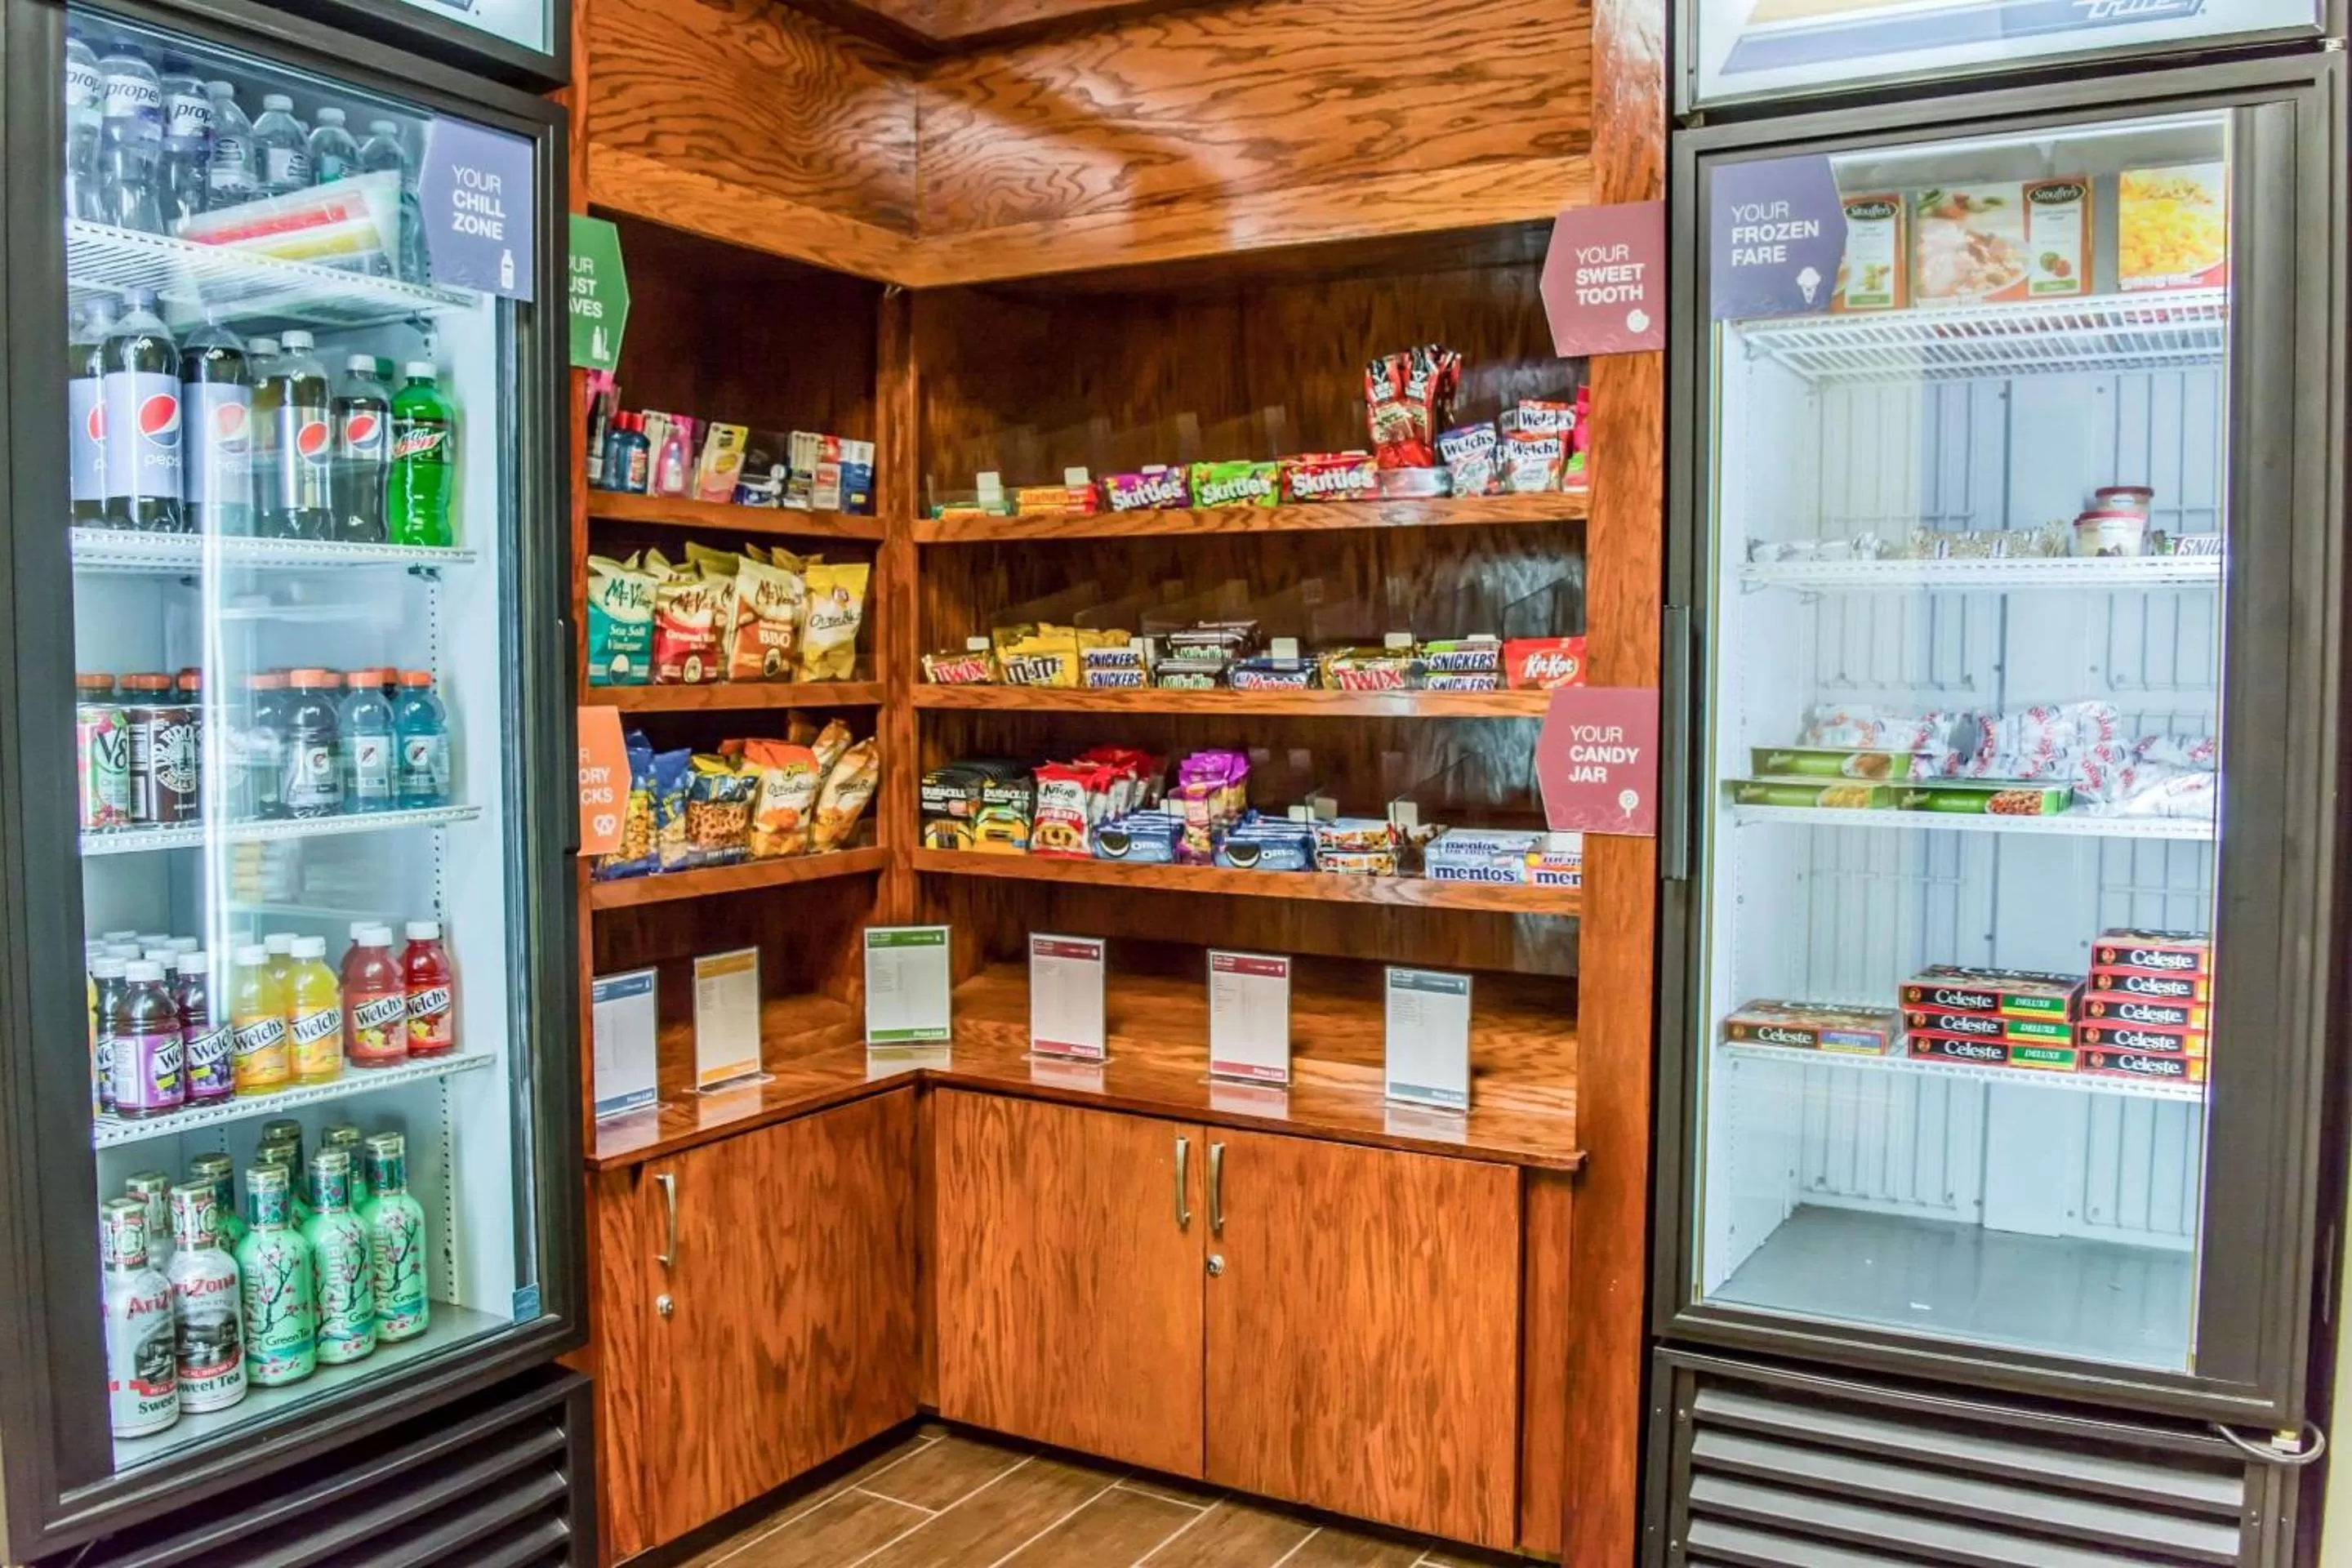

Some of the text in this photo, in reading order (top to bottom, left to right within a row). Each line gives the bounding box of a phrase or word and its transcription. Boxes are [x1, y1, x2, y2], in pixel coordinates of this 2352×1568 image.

[452, 164, 501, 194] YOUR
[2034, 185, 2078, 202] Stouffer's
[452, 189, 506, 219] CHILL
[1731, 201, 1789, 223] YOUR
[1850, 203, 1891, 218] Stouffer's
[452, 212, 505, 240] ZONE
[1731, 220, 1820, 244] FROZEN
[1575, 243, 1629, 265] YOUR
[1731, 245, 1787, 266] FARE
[1575, 263, 1646, 286] SWEET
[1575, 284, 1644, 306] TOOTH
[1200, 475, 1271, 505] Skittles
[1291, 468, 1374, 497] Skittles
[1109, 479, 1184, 511] Skittles
[758, 630, 791, 648] BBQ
[1088, 653, 1138, 668] SNICKERS
[1432, 653, 1494, 670] SNICKERS
[1090, 672, 1142, 688] SNICKERS
[1335, 669, 1405, 690] TWIX
[1569, 725, 1624, 743] YOUR
[96, 726, 127, 769] V8
[1569, 745, 1640, 764] CANDY
[1568, 765, 1608, 783] JAR
[1434, 866, 1515, 882] mentos
[2130, 950, 2195, 969] Celeste
[2127, 976, 2190, 996] Celeste
[1934, 989, 2051, 1009] Celeste DELUXE
[2119, 1002, 2183, 1022] Celeste
[1940, 1014, 2056, 1034] Celeste DELUXE
[1757, 1027, 1812, 1045] Celeste
[2114, 1029, 2177, 1049] Celeste
[1944, 1040, 2061, 1060] Celeste DELUXE
[2118, 1055, 2181, 1075] Celeste
